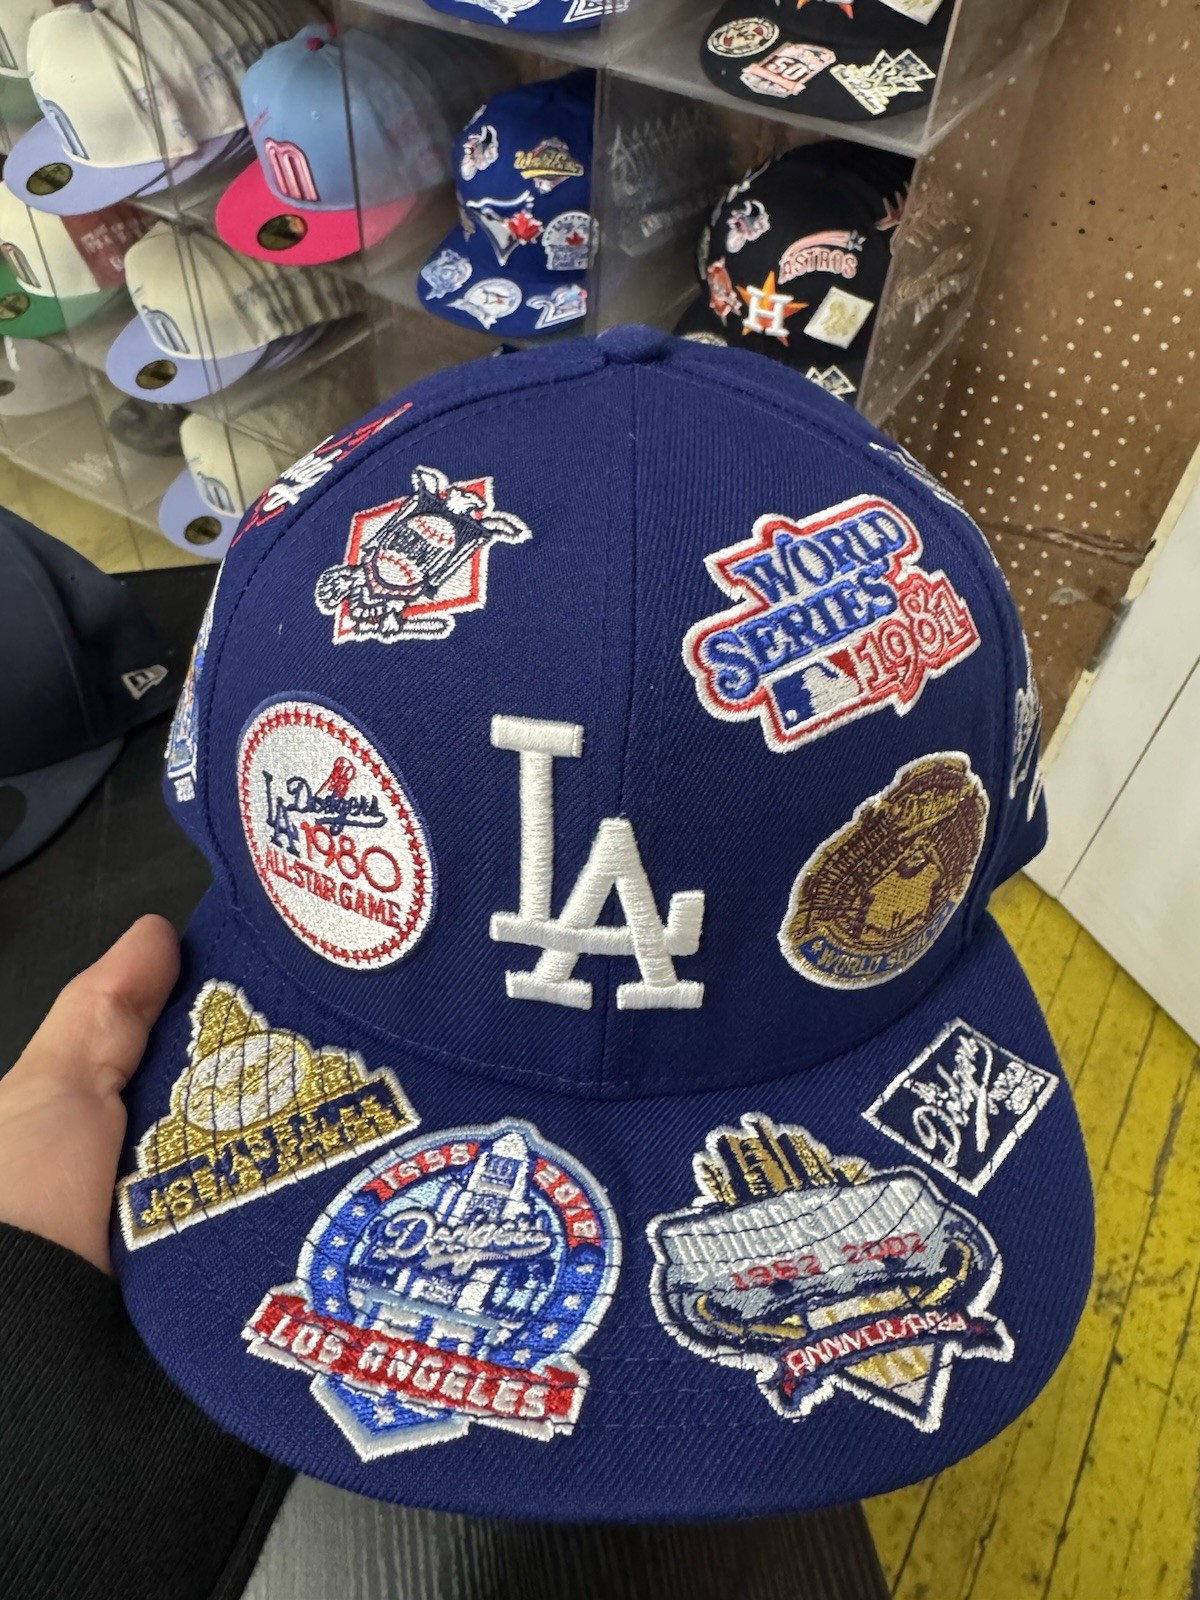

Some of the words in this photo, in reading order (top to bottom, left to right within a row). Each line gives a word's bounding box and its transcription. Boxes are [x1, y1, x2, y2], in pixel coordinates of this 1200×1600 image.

[766, 56, 809, 81] 50
[742, 284, 795, 337] H
[732, 509, 906, 604] WORLD
[705, 556, 898, 699] SERIES
[856, 577, 975, 702] 1981
[262, 770, 301, 858] LA
[286, 775, 388, 836] Dodgers
[300, 820, 403, 893] 1980
[489, 714, 706, 1011] LA
[339, 882, 403, 928] GAME
[816, 945, 884, 976] WORLD
[534, 1165, 599, 1240] 2018
[841, 1231, 927, 1265] 2002
[271, 1313, 348, 1368] LOS
[357, 1339, 549, 1419] ANGELES
